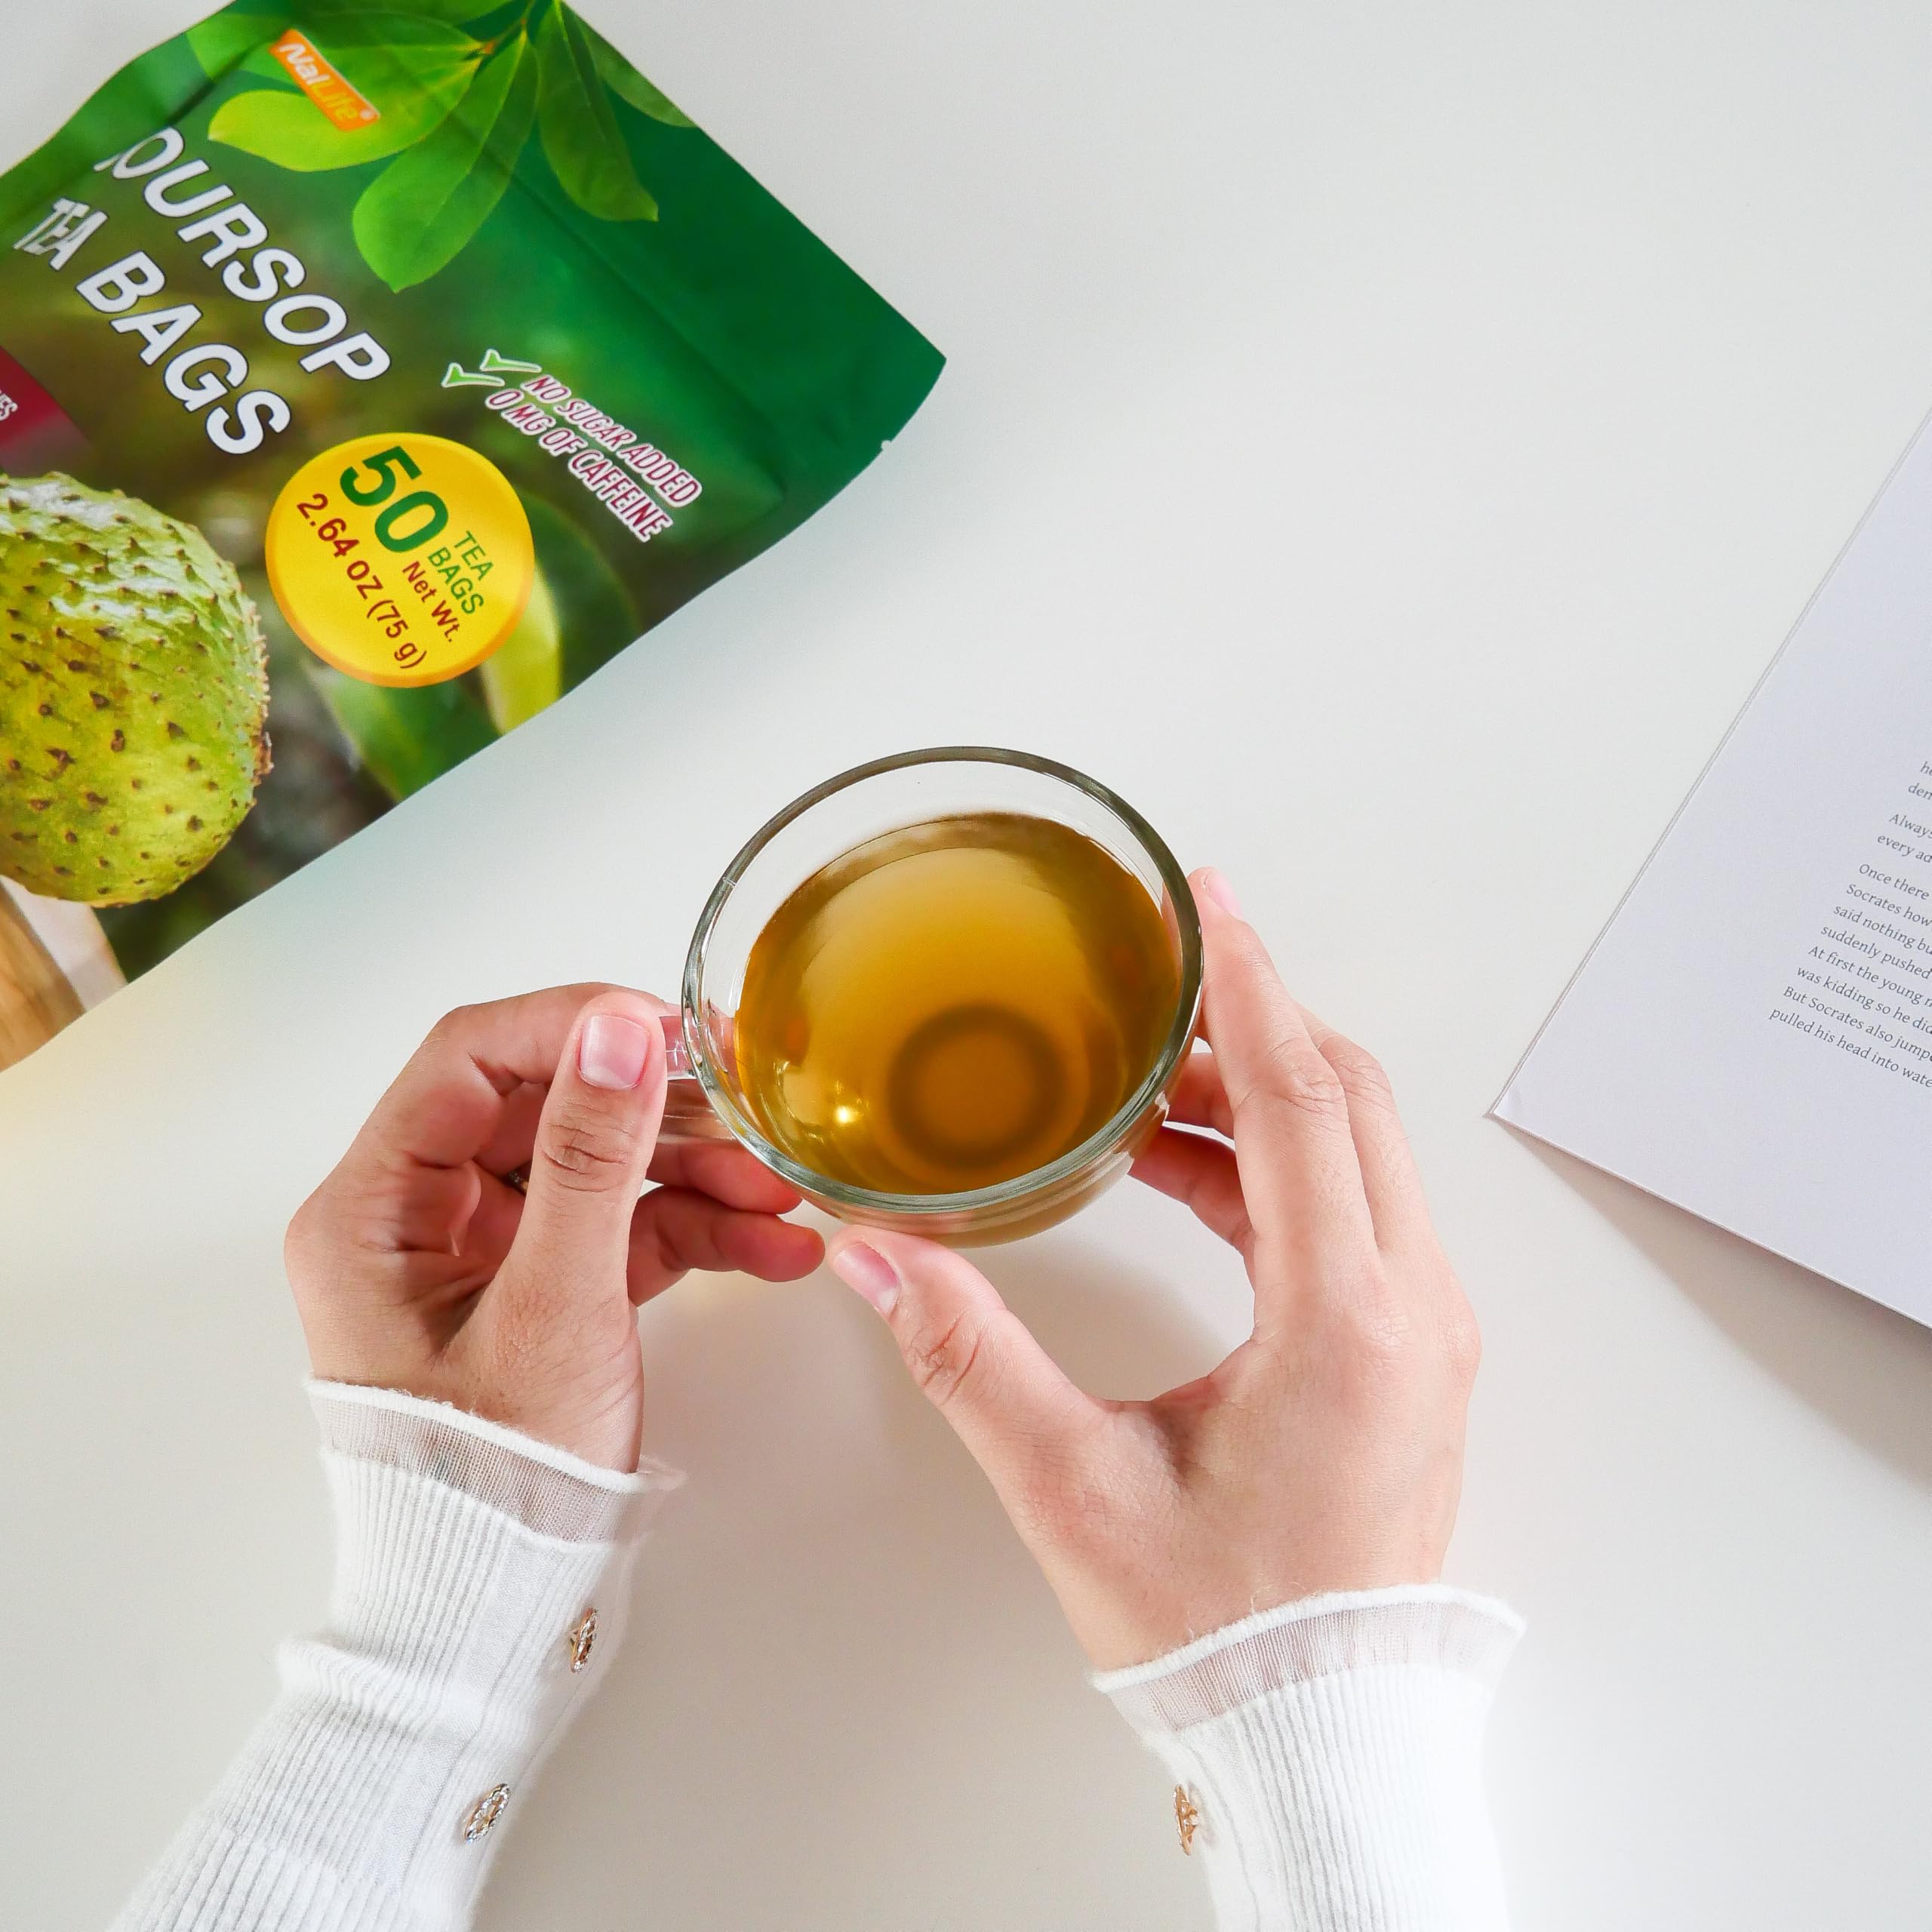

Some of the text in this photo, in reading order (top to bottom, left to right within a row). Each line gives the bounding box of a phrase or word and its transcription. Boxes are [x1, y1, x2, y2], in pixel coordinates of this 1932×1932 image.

[93, 126, 391, 381] OURSOP
[12, 198, 291, 454] TEA BAGS
[521, 375, 703, 508] NO SUGAR ADDED
[340, 445, 449, 552] 50
[502, 401, 556, 436] MG
[538, 428, 588, 457] OF
[568, 449, 673, 543] CAFFEINE
[297, 493, 427, 669] 2.64 OZ (75 g)
[427, 546, 485, 615] BAGS
[454, 531, 494, 581] TEA
[402, 561, 460, 643] Net Wt.
[1877, 835, 1915, 857] every
[1888, 814, 1932, 838] Always
[1846, 884, 1932, 926] Socrates how
[1859, 864, 1929, 900] Once there
[1820, 926, 1932, 979] suddenly pushed
[1833, 906, 1863, 924] said
[1863, 918, 1915, 949] nothing
[1797, 967, 1821, 984] was
[1823, 976, 1875, 1010] kidding
[1875, 1002, 1890, 1014] so
[1893, 1007, 1910, 1023] he
[1808, 946, 1825, 959] At
[1826, 952, 1855, 972] first
[1857, 966, 1879, 983] the
[1878, 978, 1924, 1005] young
[1769, 1009, 1815, 1033] pulled
[1814, 1025, 1835, 1044] his
[1836, 1035, 1872, 1059] head
[1871, 1051, 1899, 1072] into
[1783, 986, 1807, 1004] But
[1808, 997, 1864, 1029] Socrates
[1866, 1025, 1893, 1042] also
